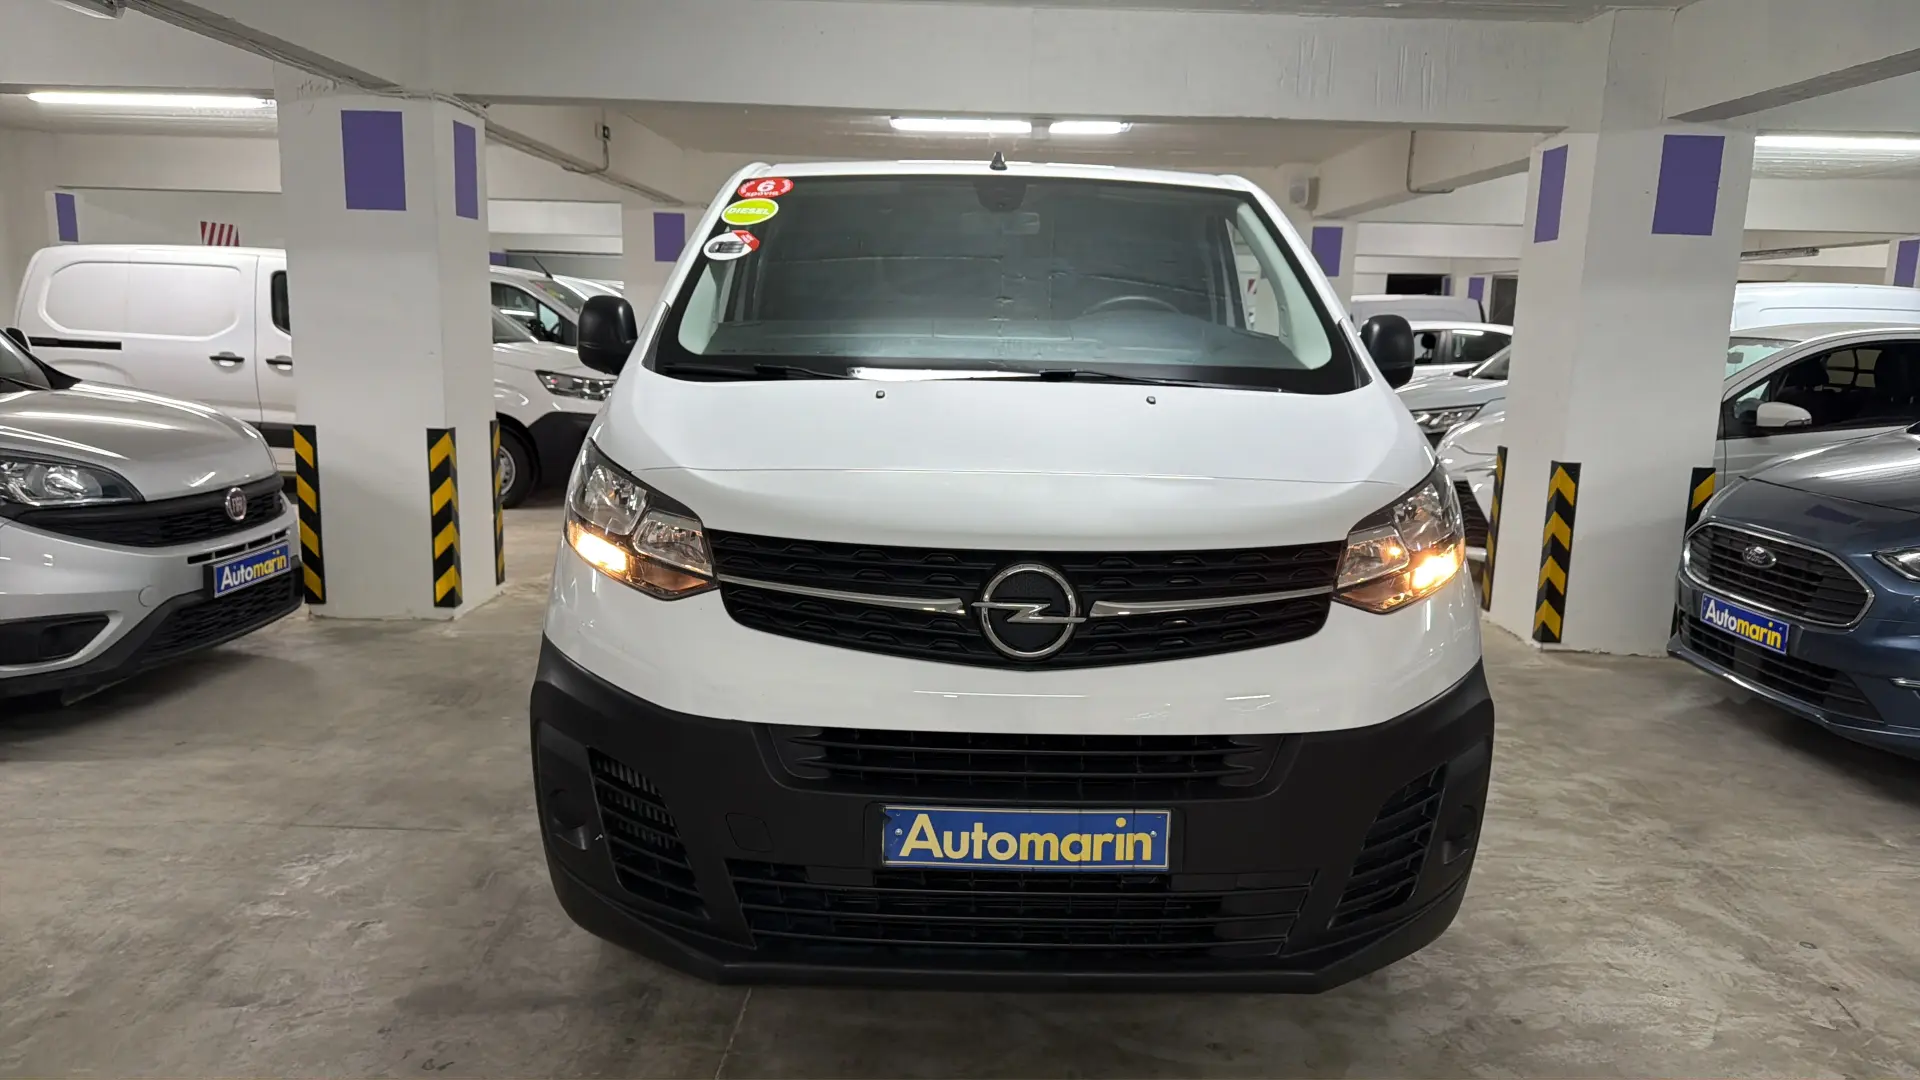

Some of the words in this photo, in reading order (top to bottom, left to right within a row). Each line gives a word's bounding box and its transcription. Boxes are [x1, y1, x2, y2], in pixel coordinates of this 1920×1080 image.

[757, 180, 776, 192] 6
[727, 207, 770, 215] DIESEL
[221, 549, 287, 590] Automarin
[1704, 599, 1782, 649] Automarin
[899, 813, 1152, 862] Automarin
